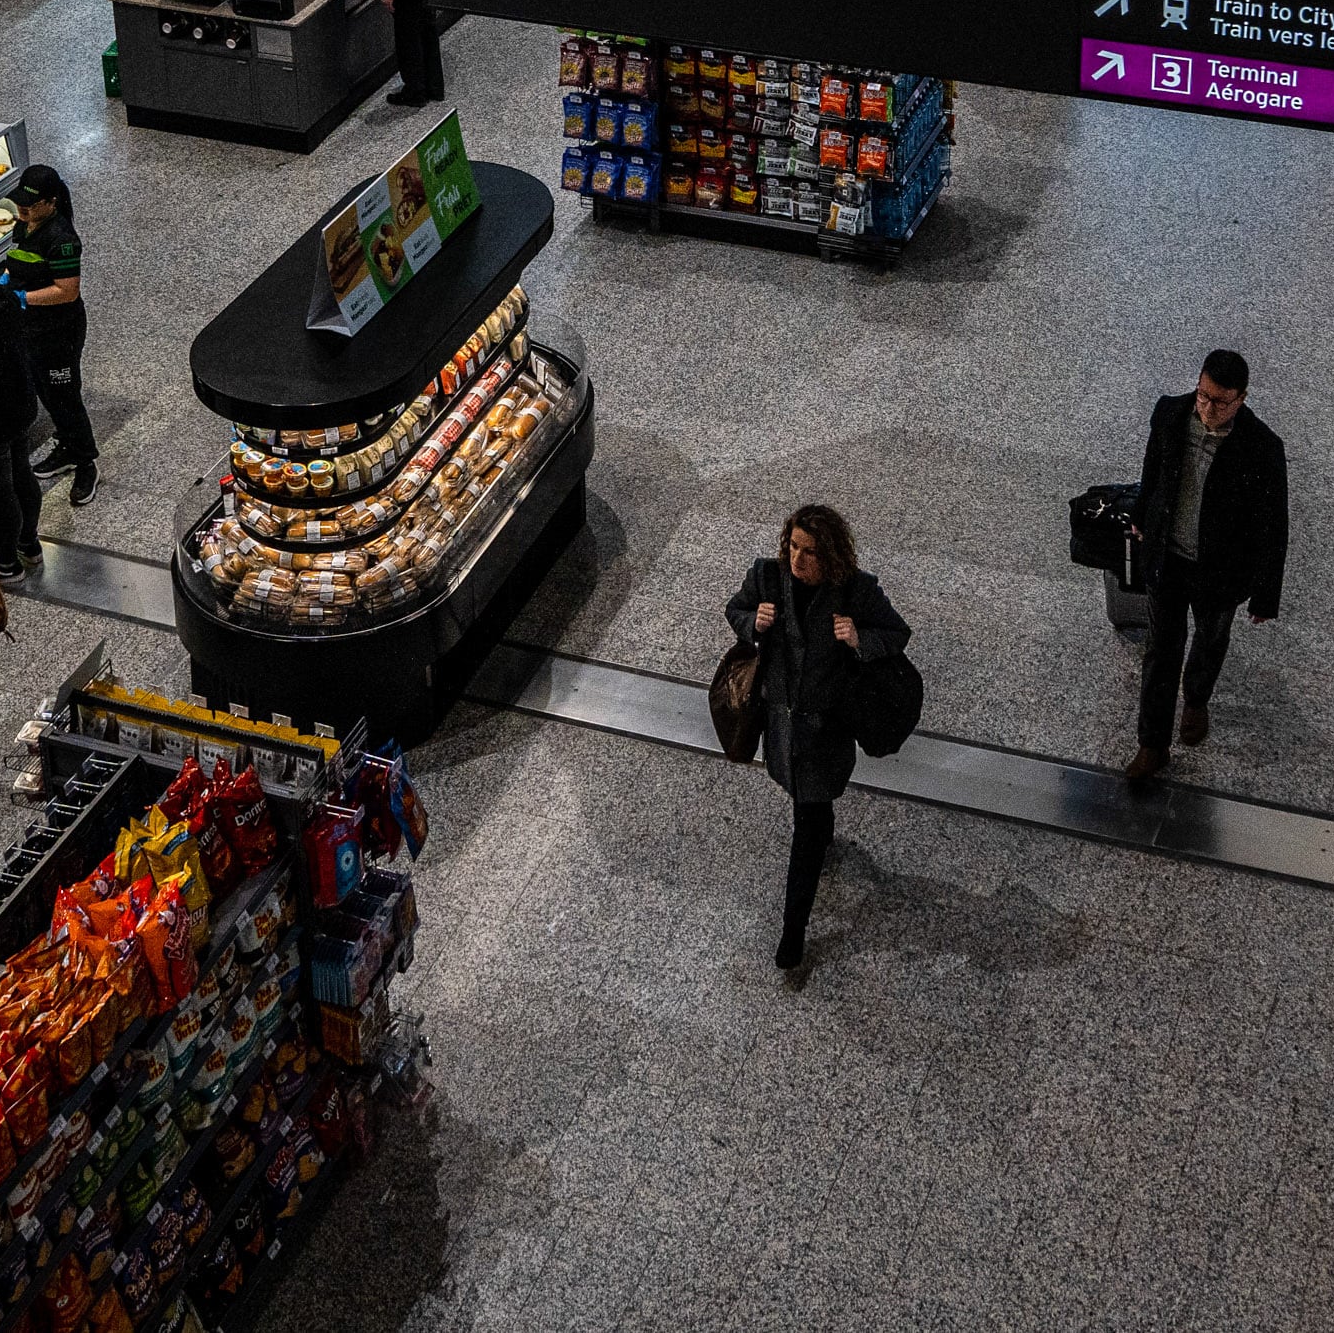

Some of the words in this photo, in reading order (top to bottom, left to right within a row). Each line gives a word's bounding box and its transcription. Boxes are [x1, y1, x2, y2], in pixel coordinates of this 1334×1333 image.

[1278, 2, 1293, 21] to
[1210, 17, 1262, 41] Train
[1269, 28, 1313, 48] vers
[1161, 62, 1181, 87] 3
[1207, 60, 1298, 88] Terminal
[1206, 81, 1304, 110] Aérogare
[434, 150, 459, 177] READY
